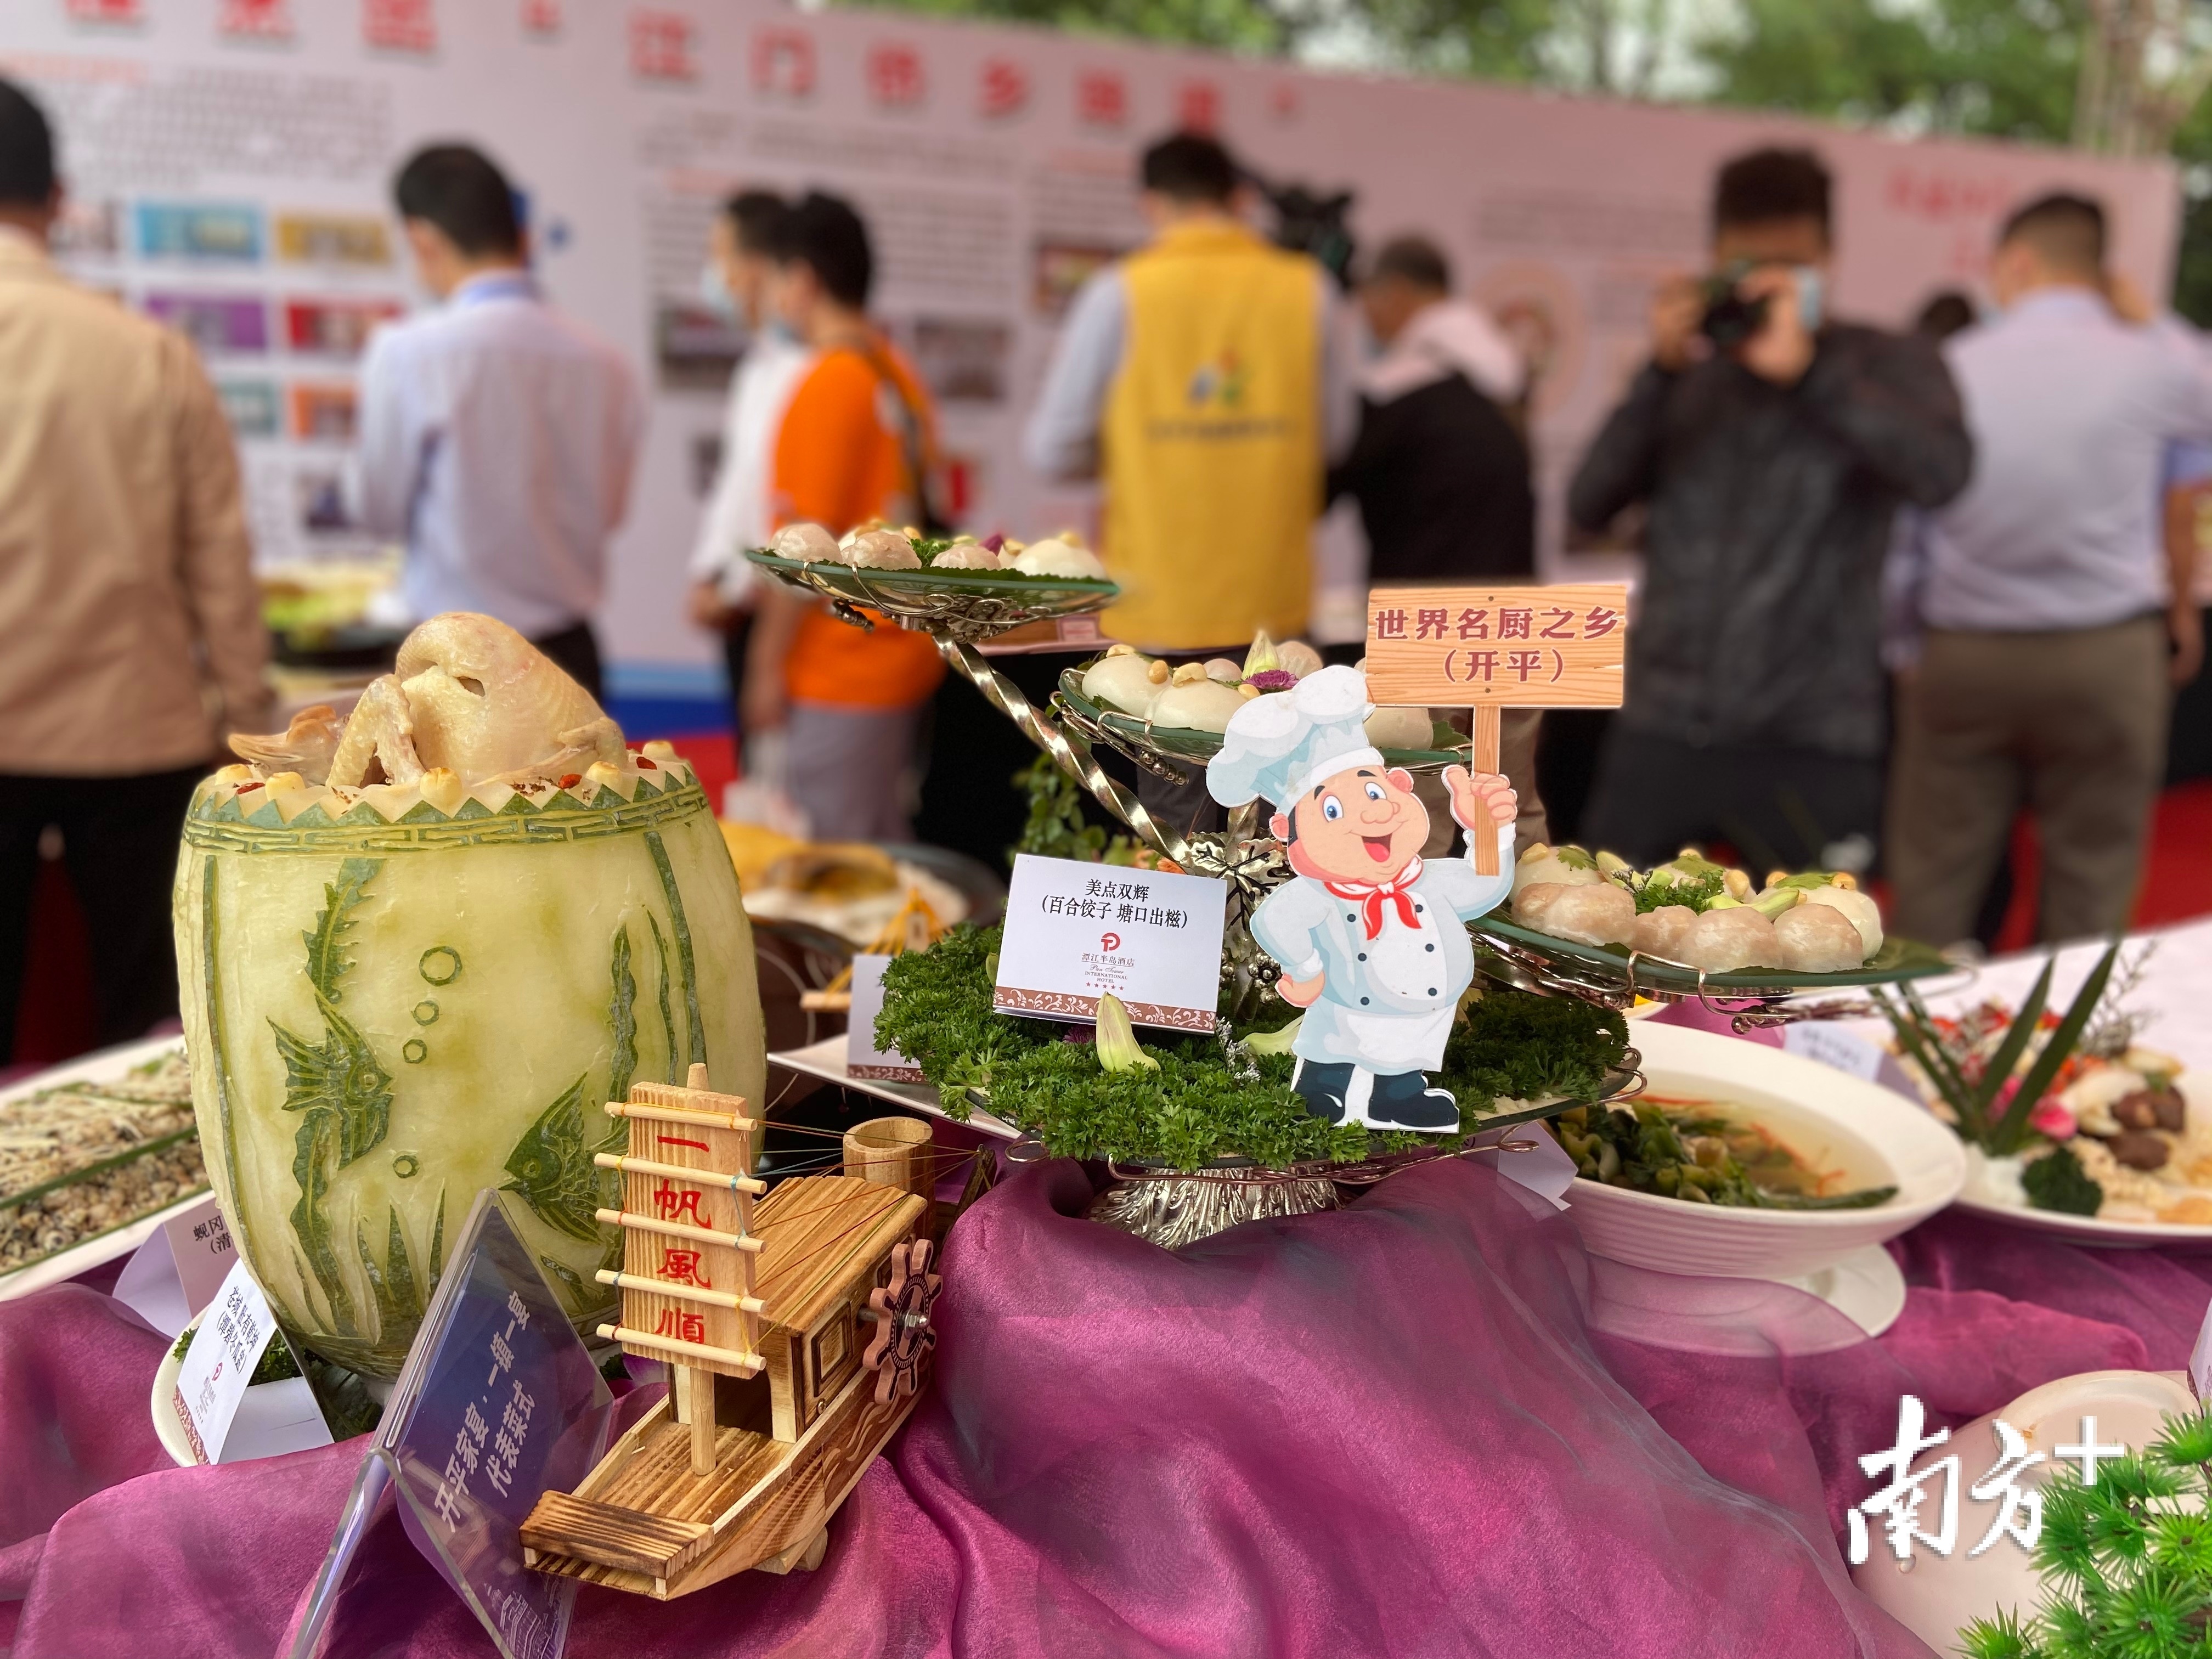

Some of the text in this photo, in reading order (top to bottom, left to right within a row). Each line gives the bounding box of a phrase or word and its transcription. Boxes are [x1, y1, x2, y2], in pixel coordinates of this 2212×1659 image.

[1375, 606, 1618, 641] 世界名厨之乡
[1444, 648, 1564, 683] （开平）
[1085, 879, 1149, 902] 美点双辉
[1041, 894, 1111, 920] (百合饺子
[1085, 971, 1128, 980] INTERNATIONAL
[485, 1379, 536, 1498] 代表菜式
